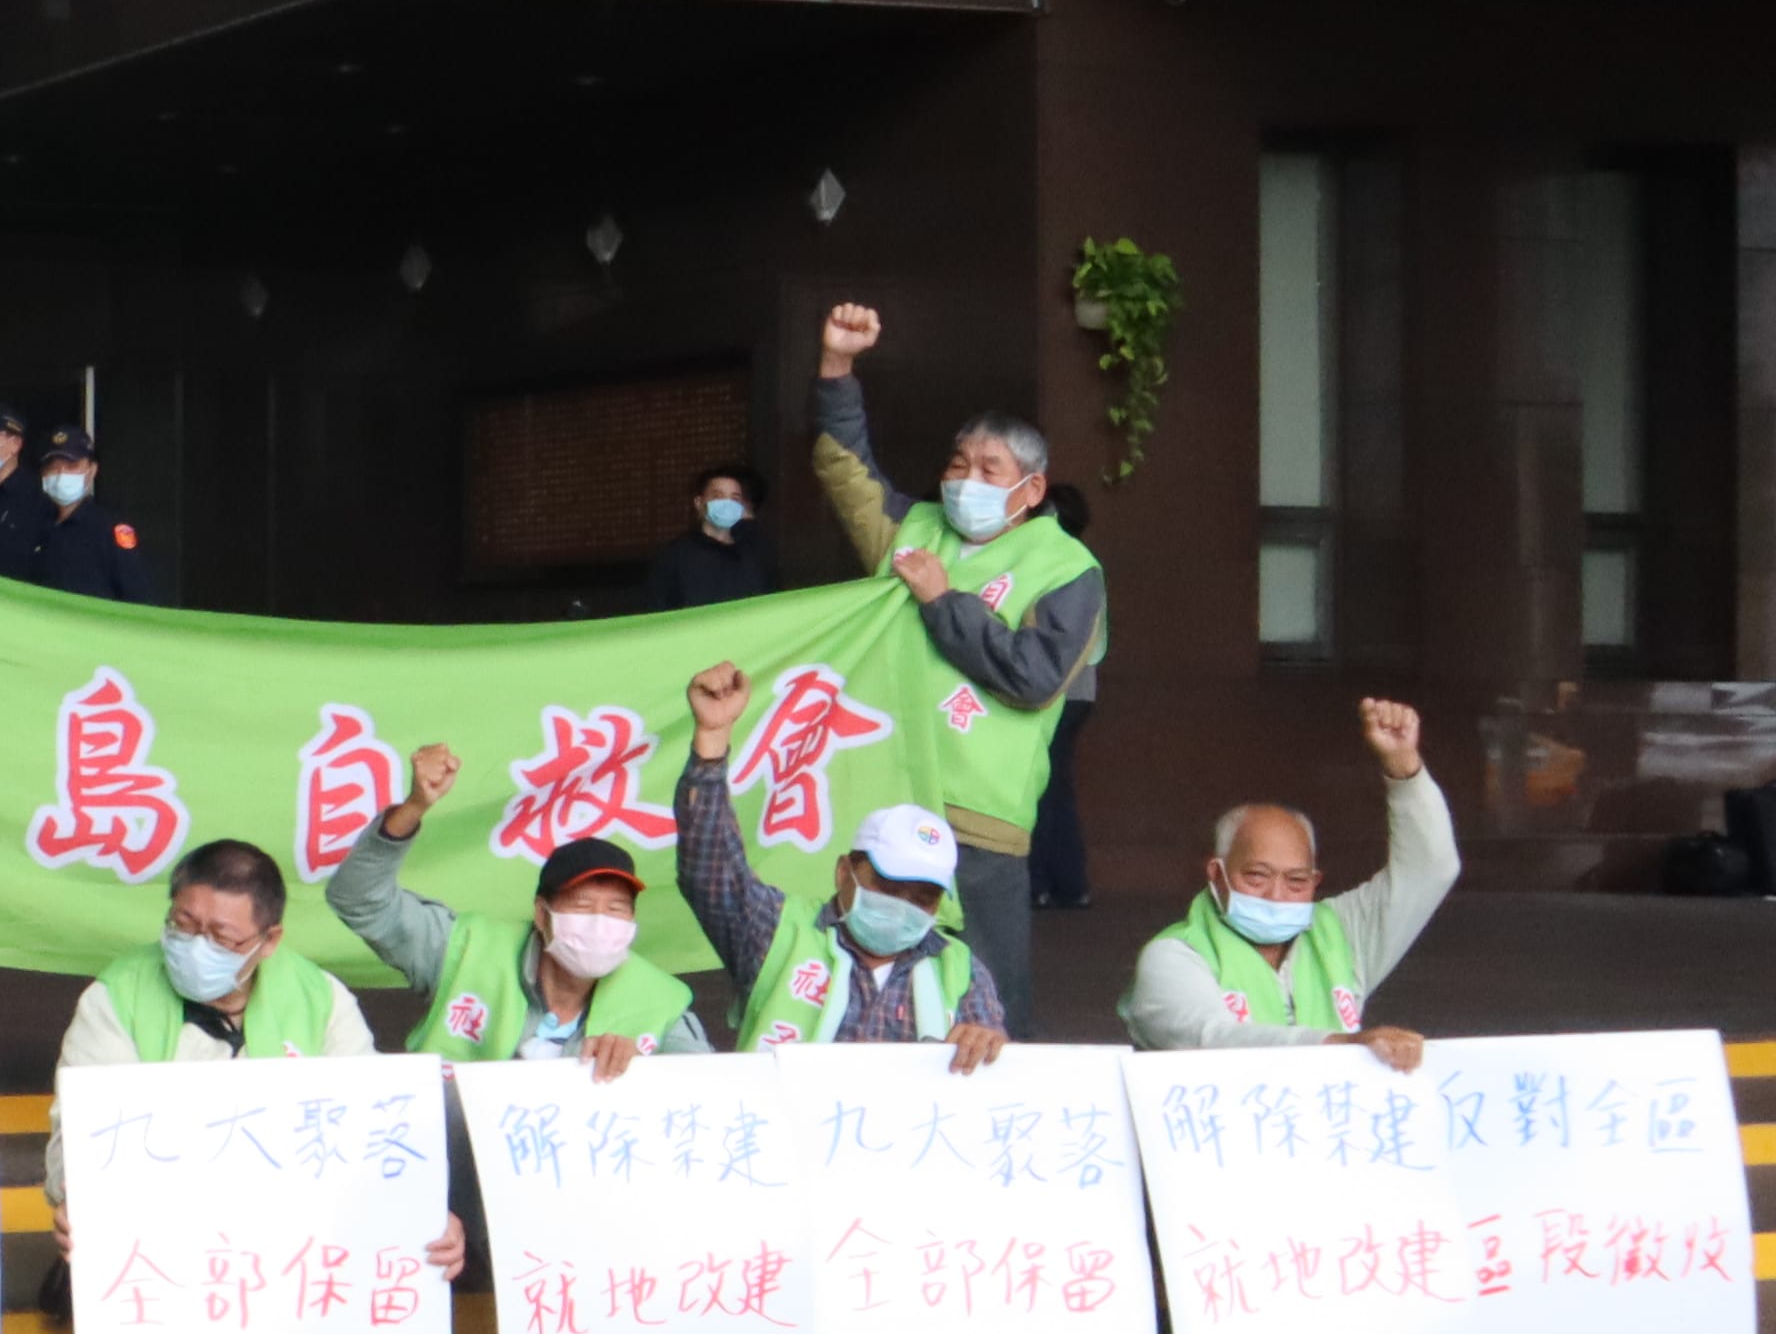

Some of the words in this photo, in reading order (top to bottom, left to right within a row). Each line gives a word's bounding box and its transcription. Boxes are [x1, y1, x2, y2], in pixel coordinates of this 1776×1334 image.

[90, 1092, 429, 1180] 九大聚落
[499, 1101, 788, 1190] 解除禁建
[820, 1101, 1128, 1191] 九大聚落
[1163, 1082, 1436, 1174] 解除禁建
[1442, 1070, 1704, 1154] 反對全區
[102, 1230, 425, 1332] 全部保留
[826, 1216, 1120, 1319] 全部保留
[1183, 1219, 1466, 1325] 就地改建
